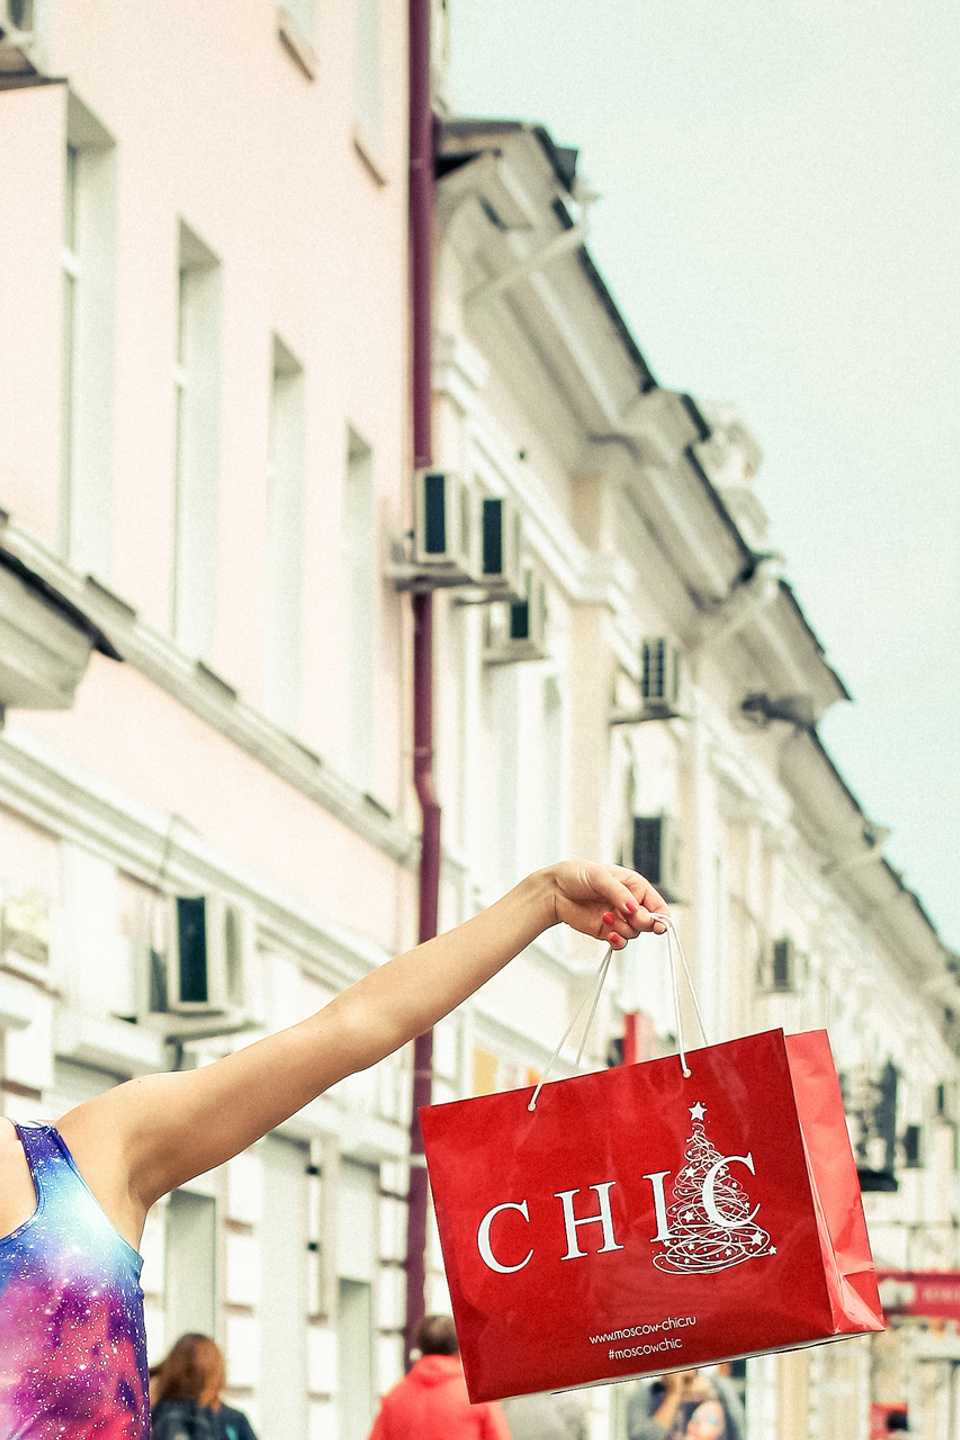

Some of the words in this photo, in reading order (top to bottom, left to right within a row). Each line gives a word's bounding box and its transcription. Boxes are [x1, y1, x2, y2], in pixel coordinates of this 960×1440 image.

[477, 1152, 761, 1274] CHIC
[589, 1316, 697, 1345] www.moscow-chic.ru
[608, 1337, 683, 1361] #moscowchic
